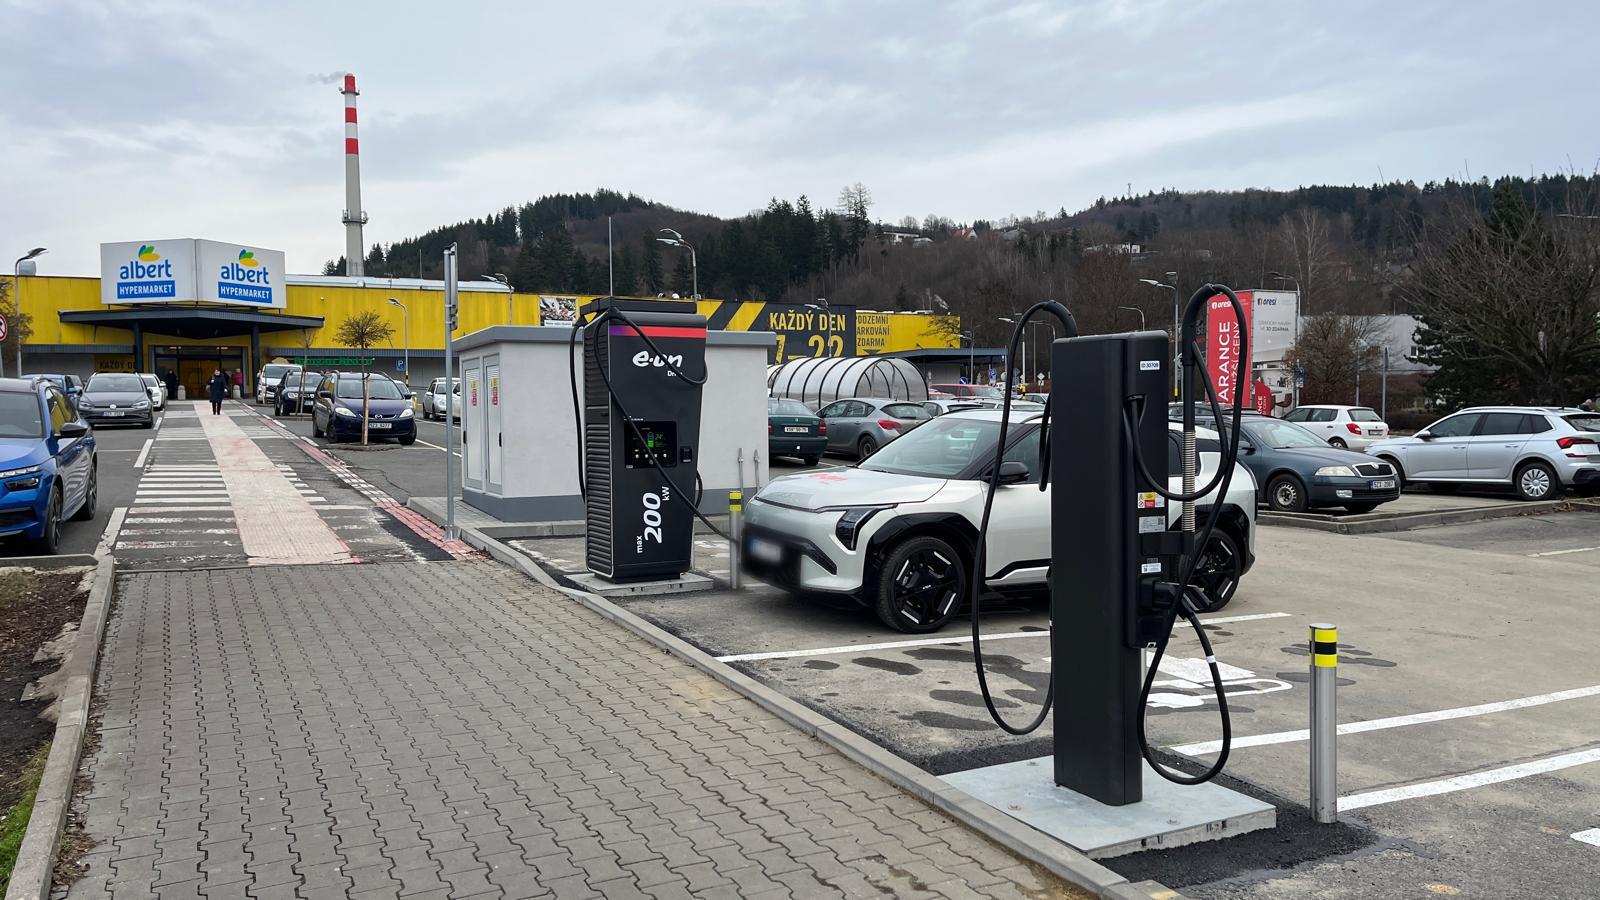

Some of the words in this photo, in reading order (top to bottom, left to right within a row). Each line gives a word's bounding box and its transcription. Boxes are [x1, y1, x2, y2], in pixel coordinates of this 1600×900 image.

[120, 259, 172, 279] albert
[221, 263, 269, 284] albert
[120, 284, 172, 295] HYPERMARKET
[221, 286, 270, 299] HYPERMARKET
[770, 309, 814, 331] KAŽDÝ
[819, 314, 846, 331] DEN
[856, 314, 888, 325] ODZEMNÍ
[857, 338, 885, 347] ZDARMA
[1218, 321, 1230, 405] ARANCE
[642, 492, 662, 544] 200
[661, 486, 670, 501] kW
